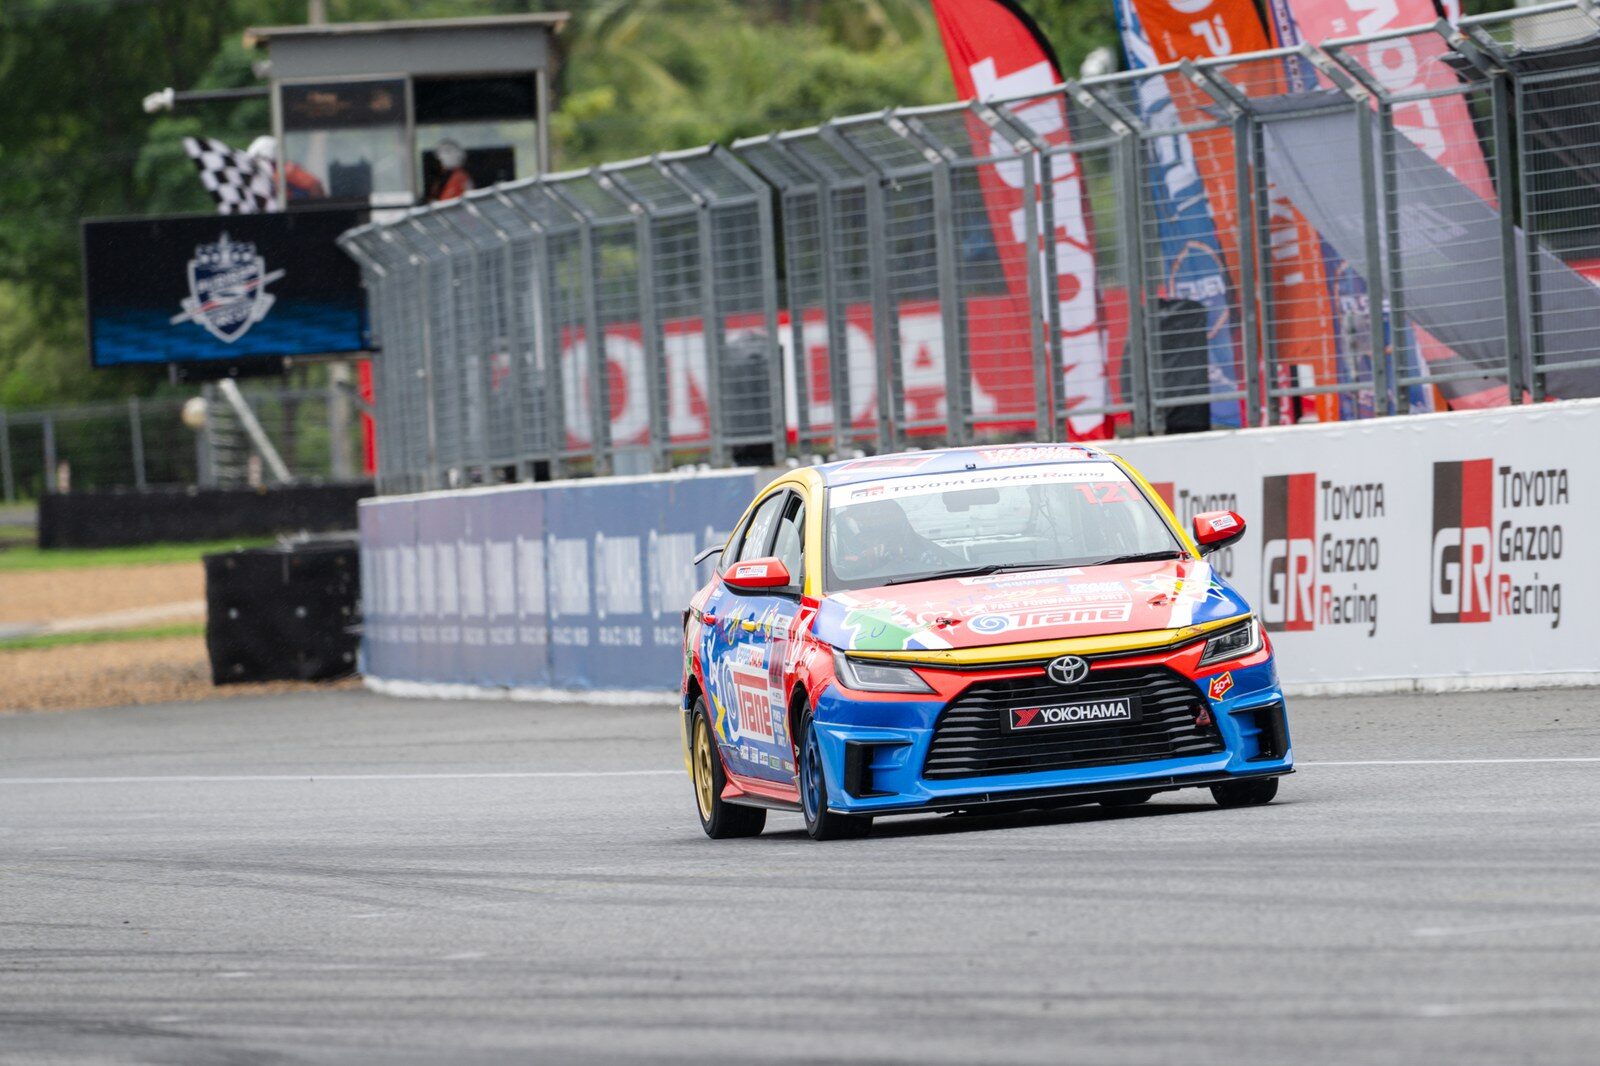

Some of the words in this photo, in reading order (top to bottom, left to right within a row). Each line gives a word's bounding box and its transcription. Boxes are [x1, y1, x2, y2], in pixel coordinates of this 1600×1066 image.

[891, 479, 966, 493] TOYOTA
[970, 473, 1039, 484] GAZOO
[1042, 470, 1105, 479] Racing
[1074, 480, 1142, 505] 121
[1321, 480, 1385, 521] TOYOTA
[1499, 466, 1569, 508] TOYOTA
[1321, 533, 1379, 573] GAZOO
[1499, 520, 1563, 562] GAZOO
[1263, 538, 1315, 623] GR
[1432, 526, 1491, 613] GR
[989, 600, 1019, 610] FAST
[1022, 596, 1080, 607] FORWARD
[1084, 593, 1125, 603] SPORT
[1009, 605, 1125, 627] Trane
[1320, 583, 1378, 637] Racing
[1498, 572, 1561, 629] Racing
[733, 671, 773, 737] Trane
[1040, 701, 1127, 723] YOKOHAMA
